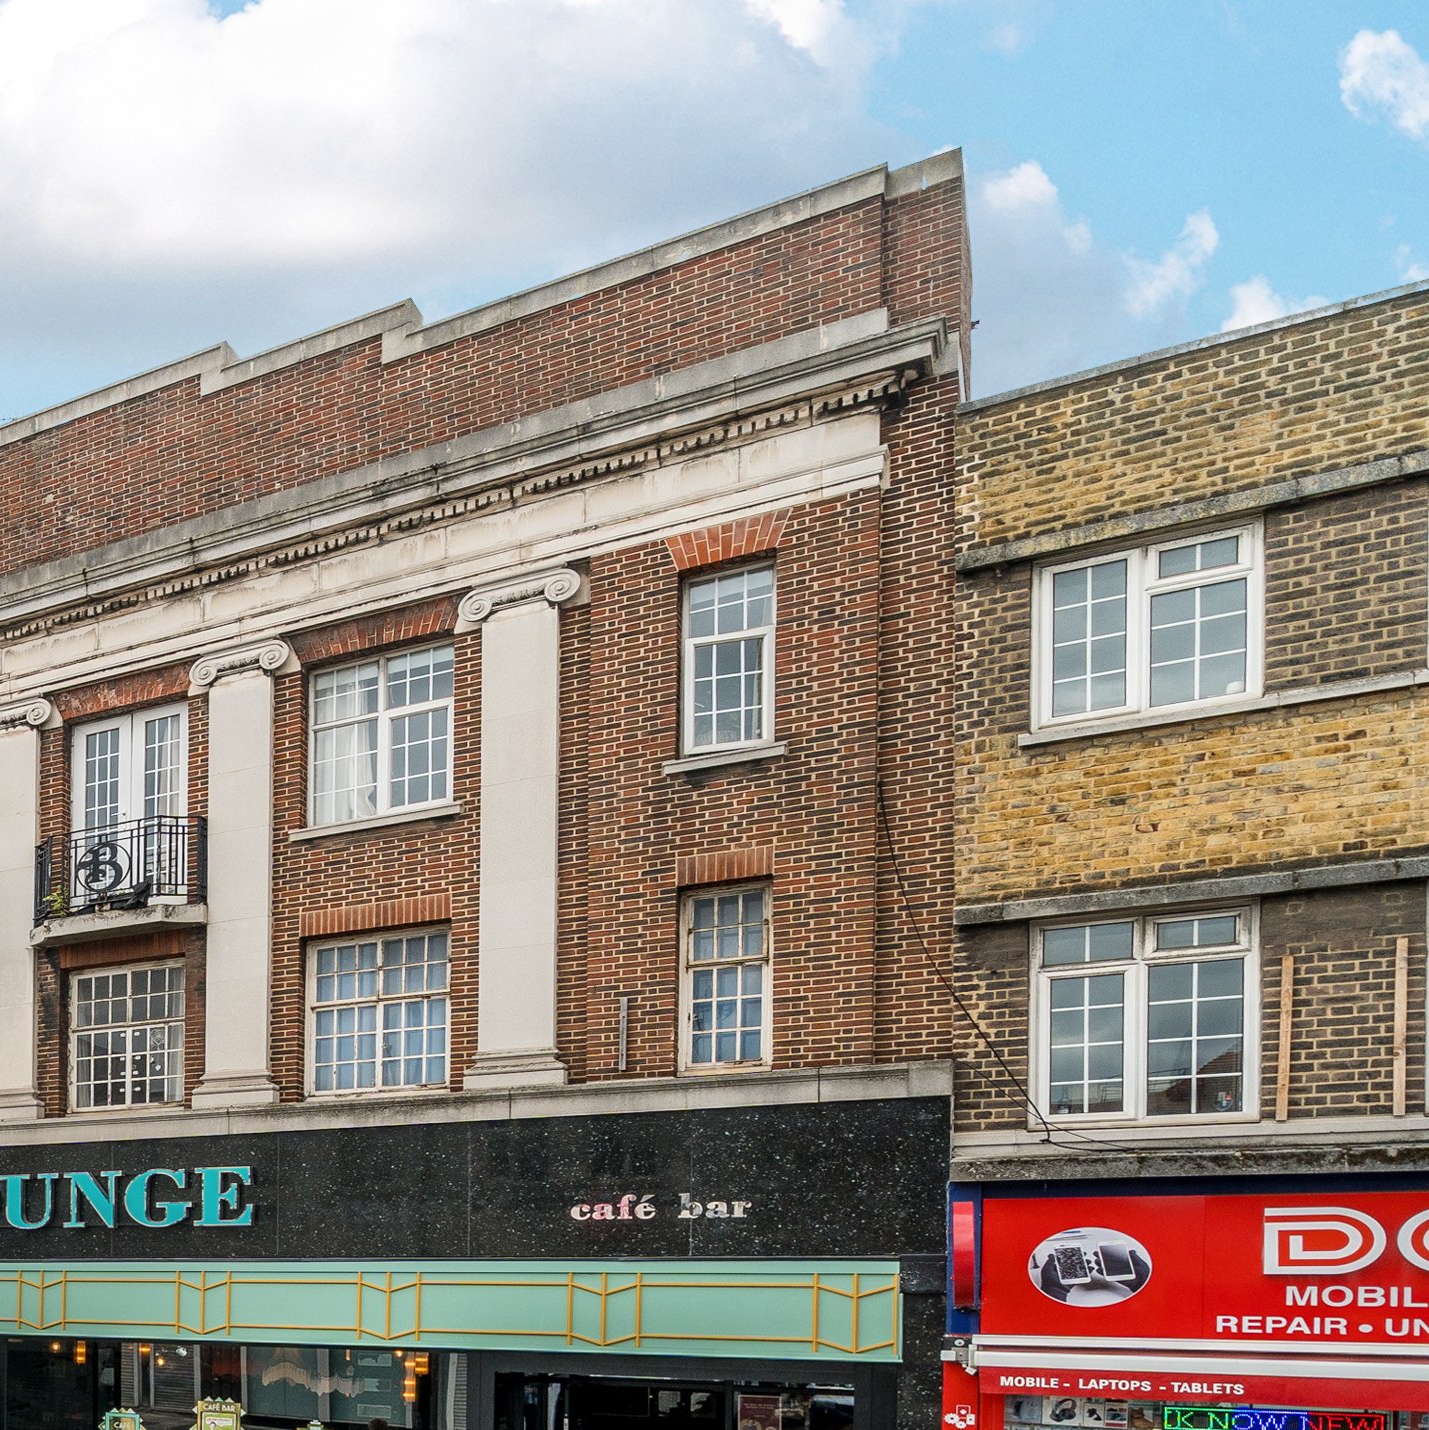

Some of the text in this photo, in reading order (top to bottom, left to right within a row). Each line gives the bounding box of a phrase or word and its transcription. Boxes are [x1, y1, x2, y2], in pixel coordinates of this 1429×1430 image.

[570, 1192, 752, 1221] café bar
[1262, 1206, 1429, 1276] D
[1285, 1285, 1429, 1308] MOBIL
[1215, 1315, 1348, 1335] REPAIR
[999, 1375, 1060, 1389] MOBILE
[1078, 1378, 1152, 1392] LAPTOPS
[1170, 1381, 1245, 1396] TABLETS
[202, 1402, 236, 1412] CAFÉ BAR
